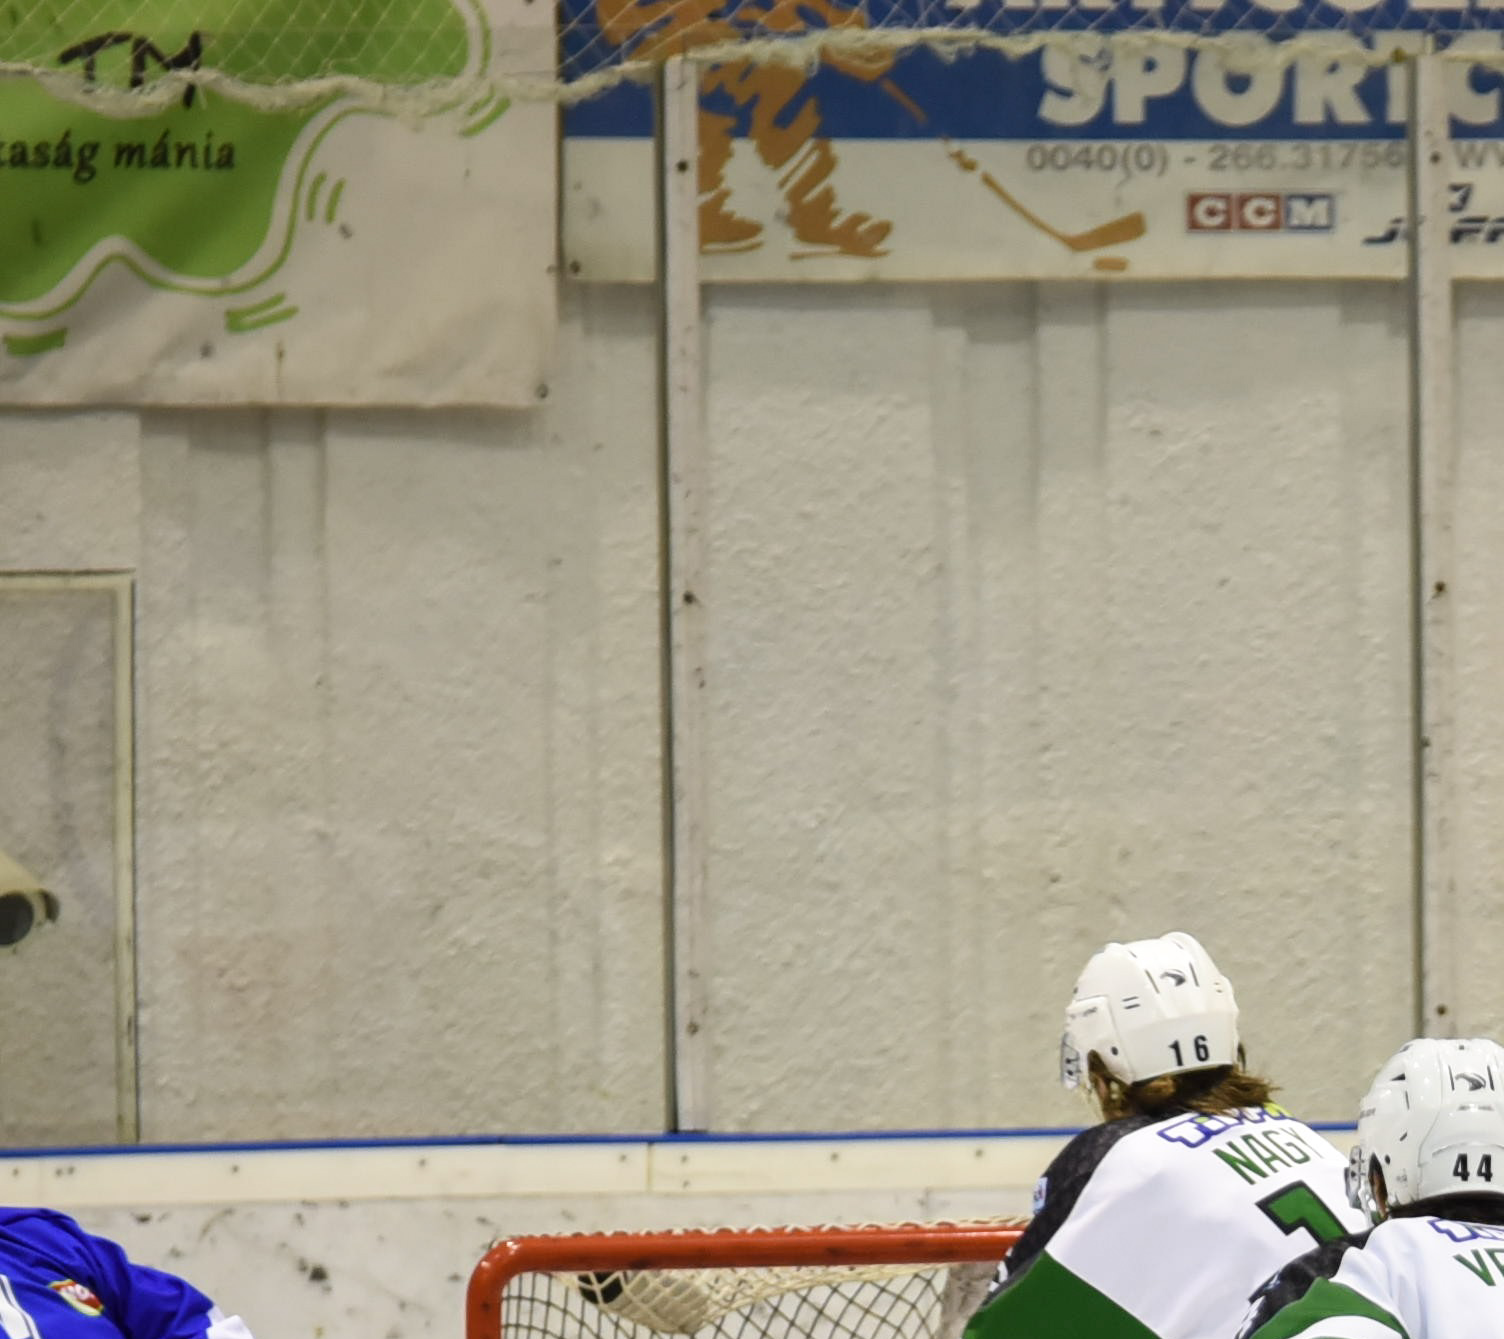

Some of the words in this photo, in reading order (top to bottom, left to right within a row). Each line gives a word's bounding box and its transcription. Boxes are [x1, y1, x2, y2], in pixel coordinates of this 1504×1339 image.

[114, 128, 237, 170] mánia
[1027, 143, 1168, 178] 0040(0)
[1187, 194, 1336, 233] CCM
[1168, 1034, 1211, 1068] 16
[1213, 1127, 1324, 1185] NAGY
[1452, 1153, 1494, 1182] 44
